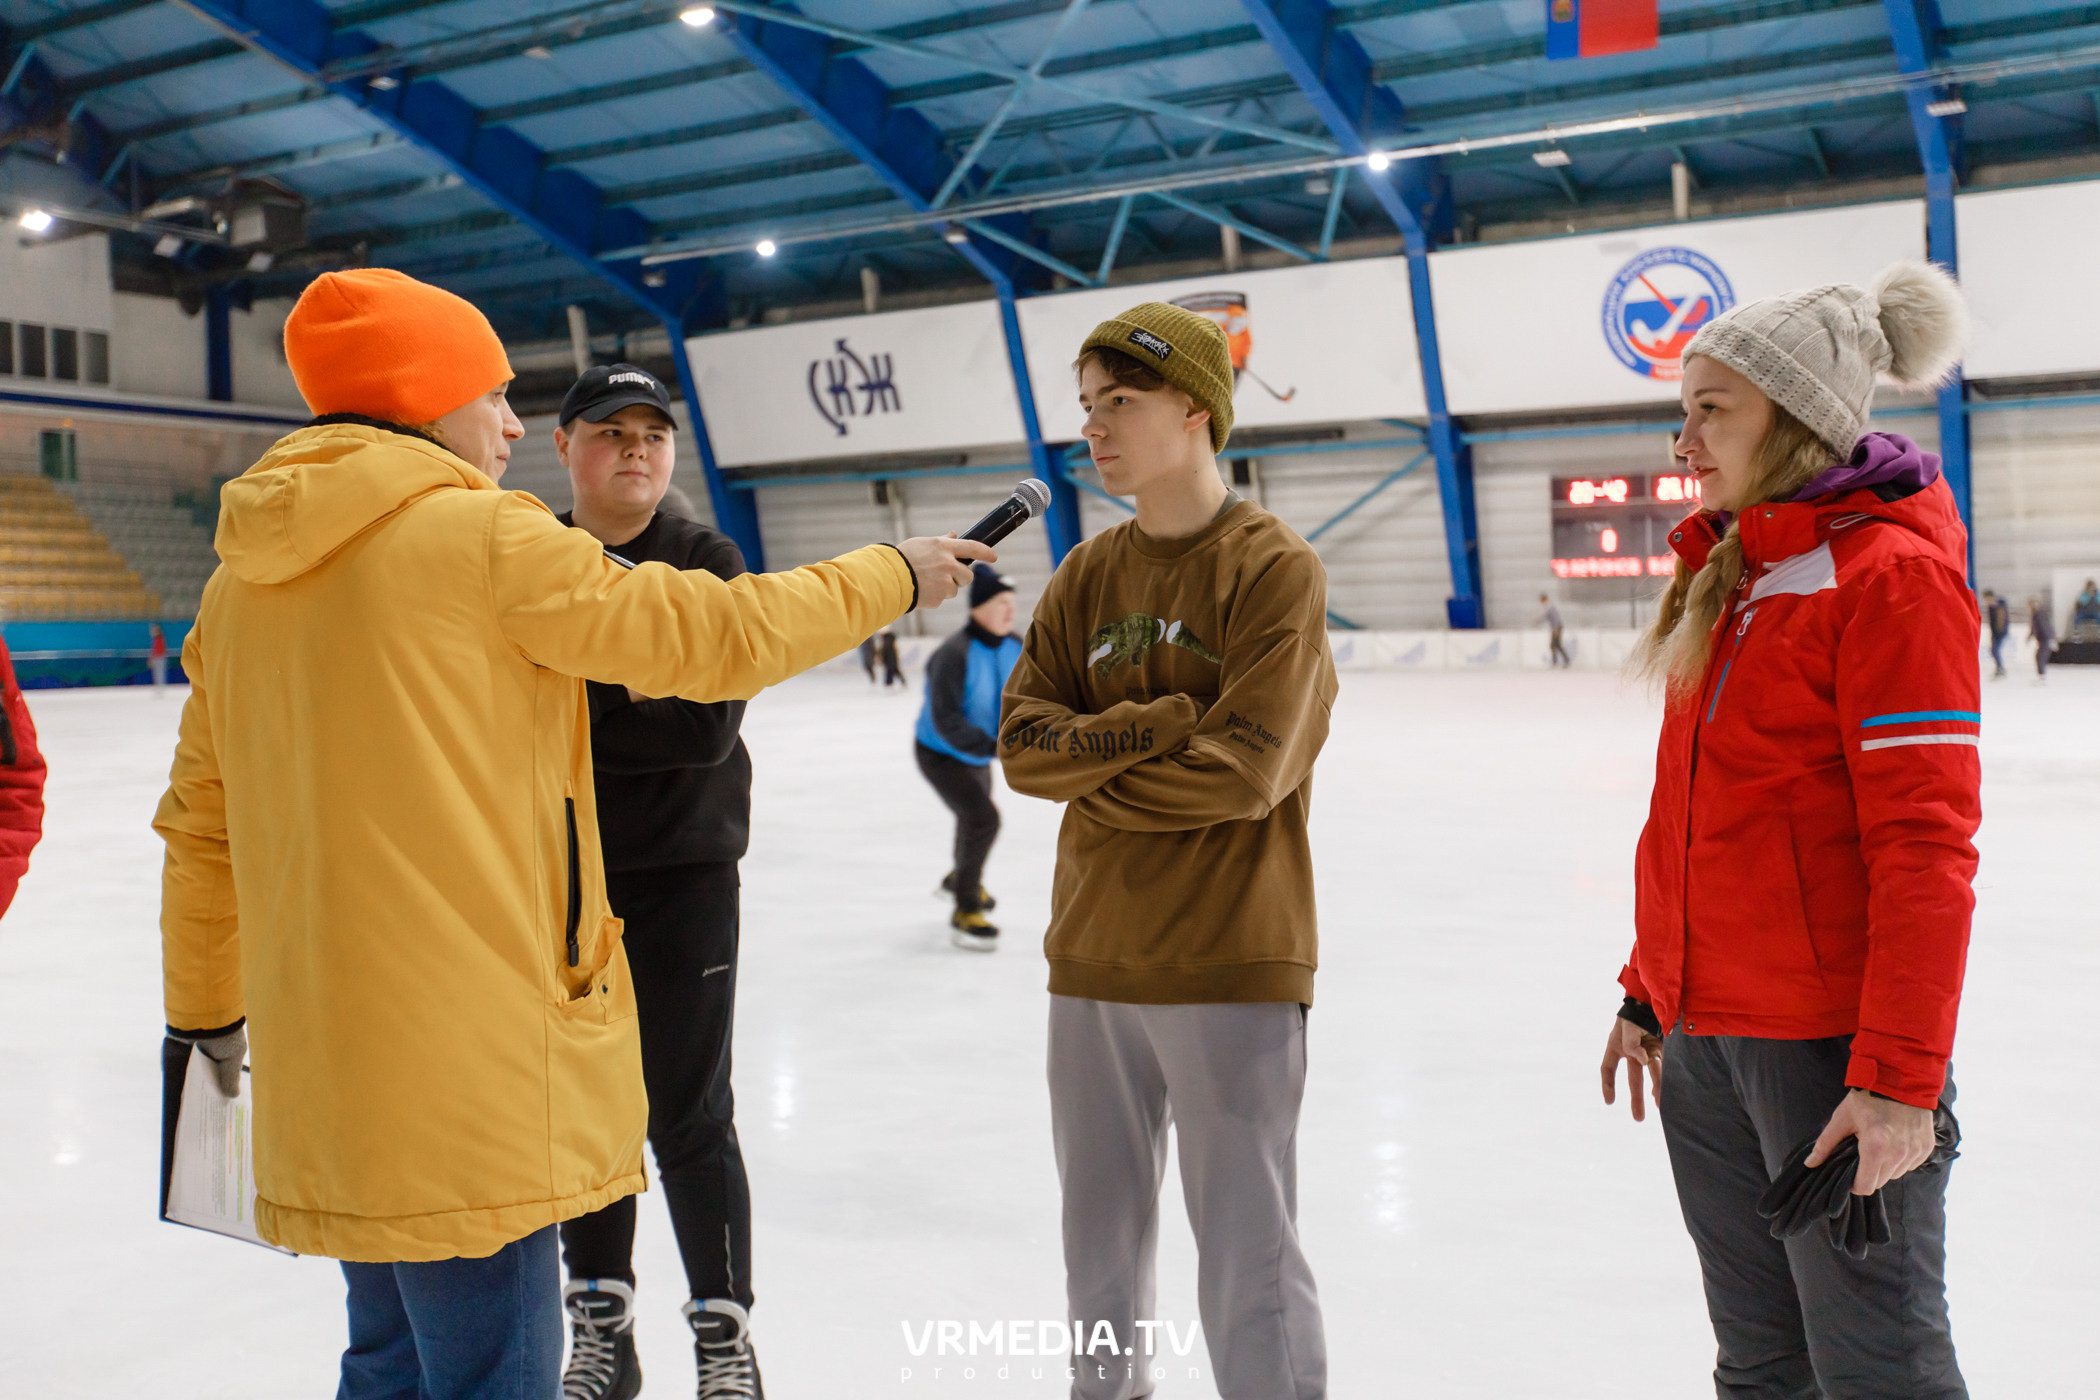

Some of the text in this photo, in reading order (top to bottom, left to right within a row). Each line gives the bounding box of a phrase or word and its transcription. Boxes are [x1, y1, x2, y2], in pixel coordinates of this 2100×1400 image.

[608, 371, 646, 385] PUMA
[1068, 721, 1154, 762] Angels
[1225, 710, 1282, 749] Palm Angels
